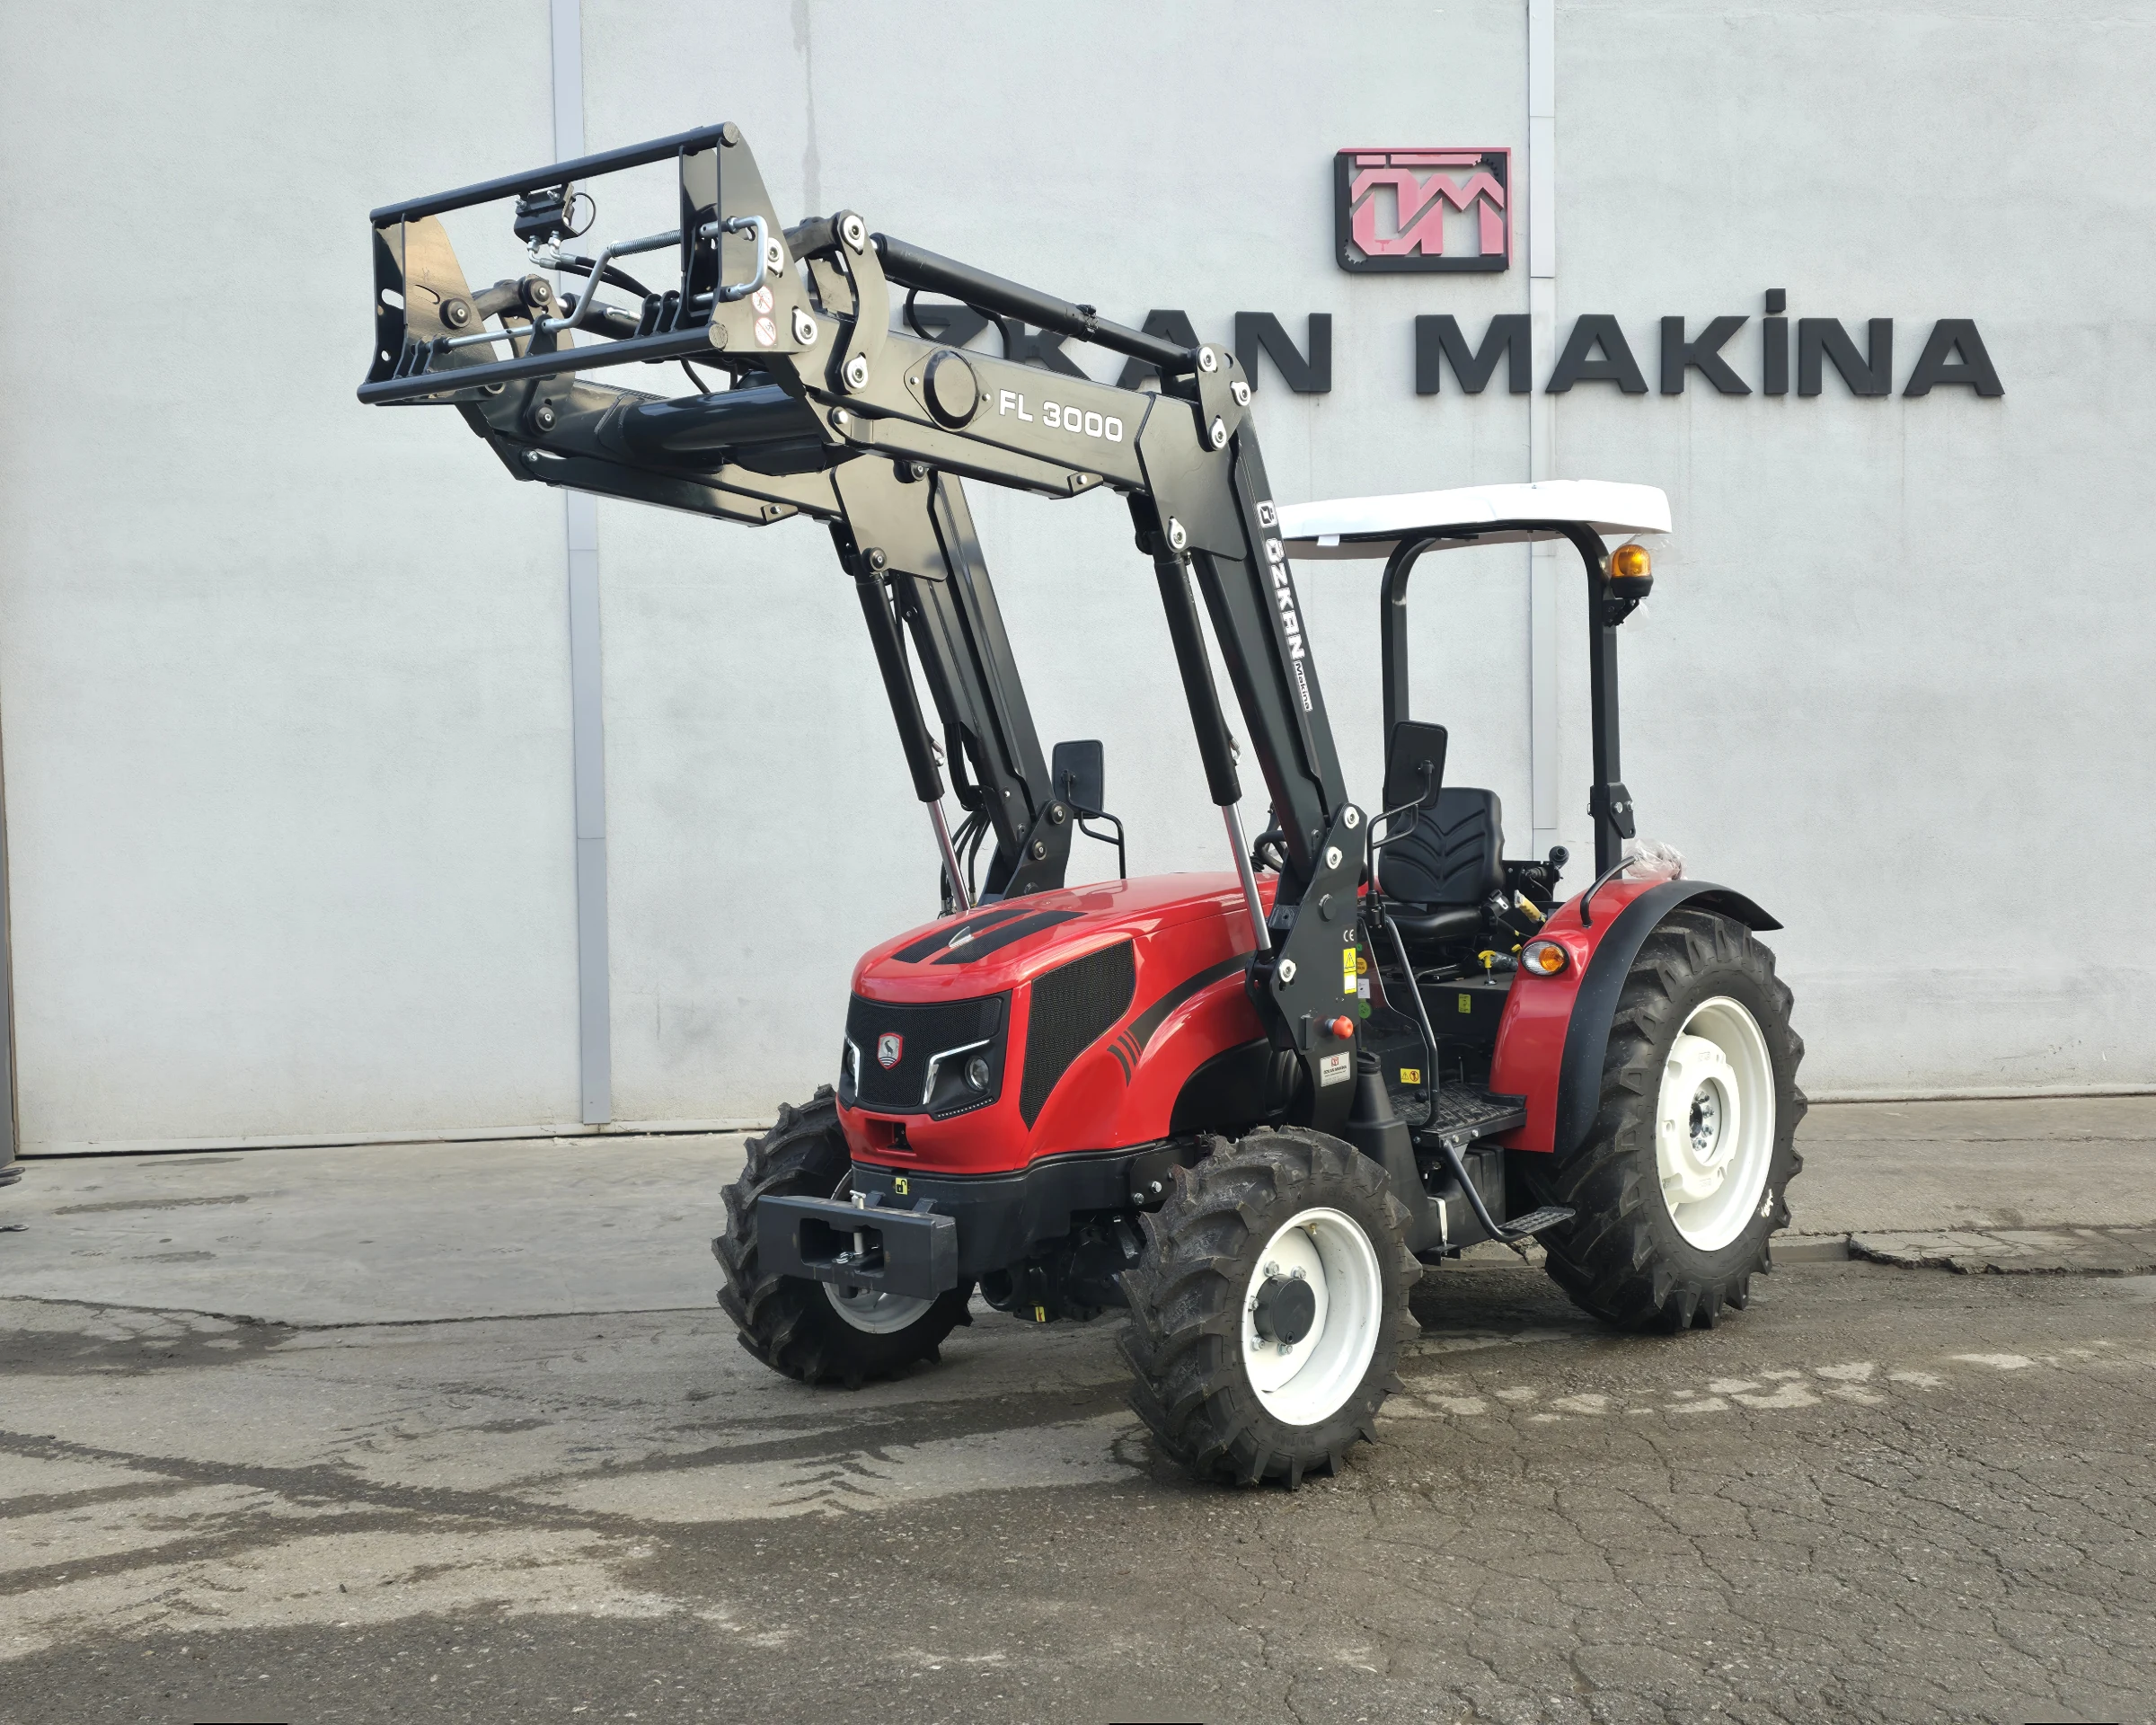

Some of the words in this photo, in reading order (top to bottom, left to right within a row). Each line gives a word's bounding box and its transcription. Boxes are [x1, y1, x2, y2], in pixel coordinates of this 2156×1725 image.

[1415, 288, 2006, 397] MAKİNA
[999, 388, 1034, 423] FL
[1042, 400, 1124, 443] 3000
[1293, 659, 1313, 712] Makina
